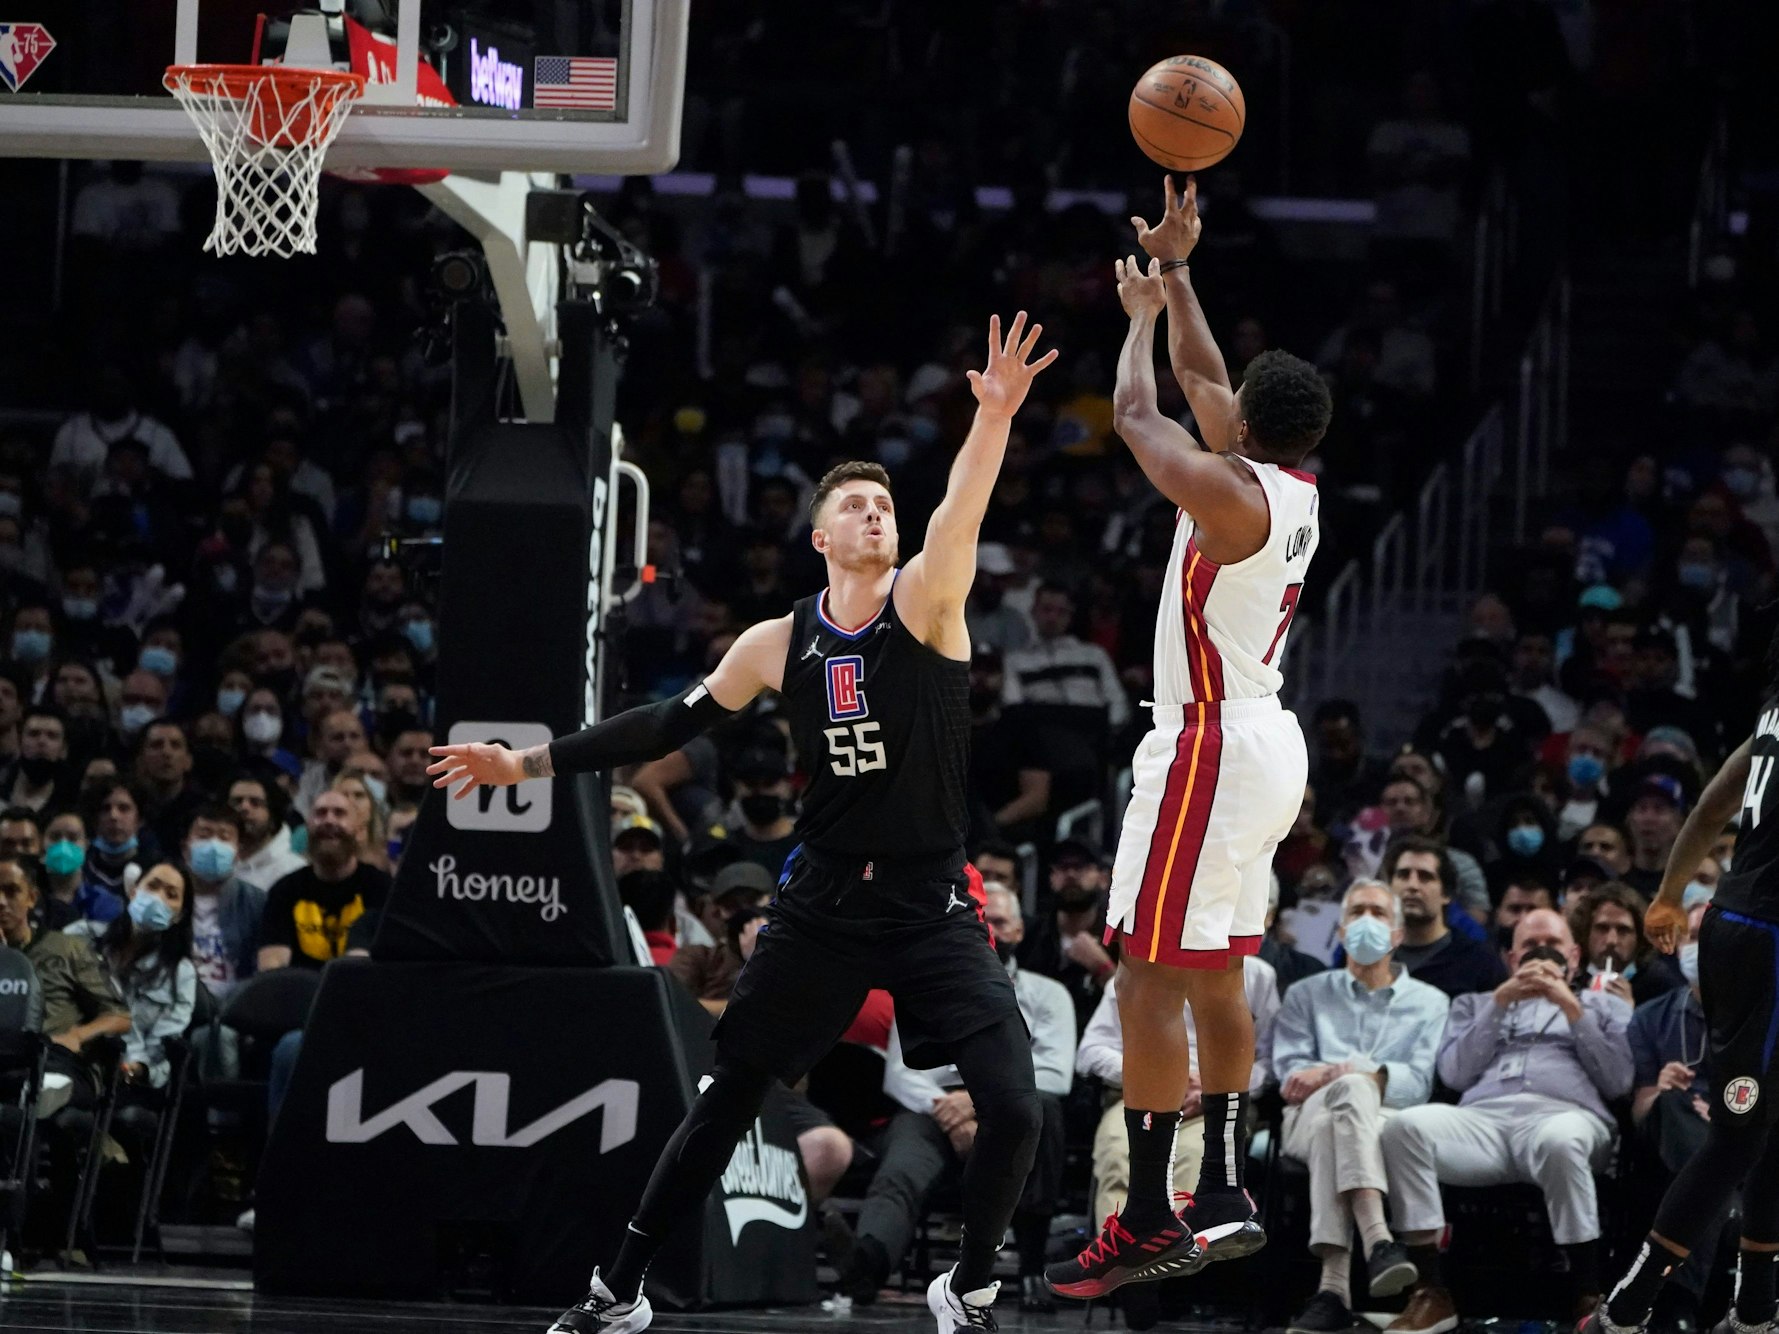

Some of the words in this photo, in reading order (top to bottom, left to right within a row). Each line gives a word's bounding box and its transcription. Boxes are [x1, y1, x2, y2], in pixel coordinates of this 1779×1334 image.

[23, 33, 39, 54] 75
[580, 476, 608, 731] betwa
[1261, 582, 1304, 666] 7
[823, 721, 887, 777] 55
[428, 854, 568, 922] honey
